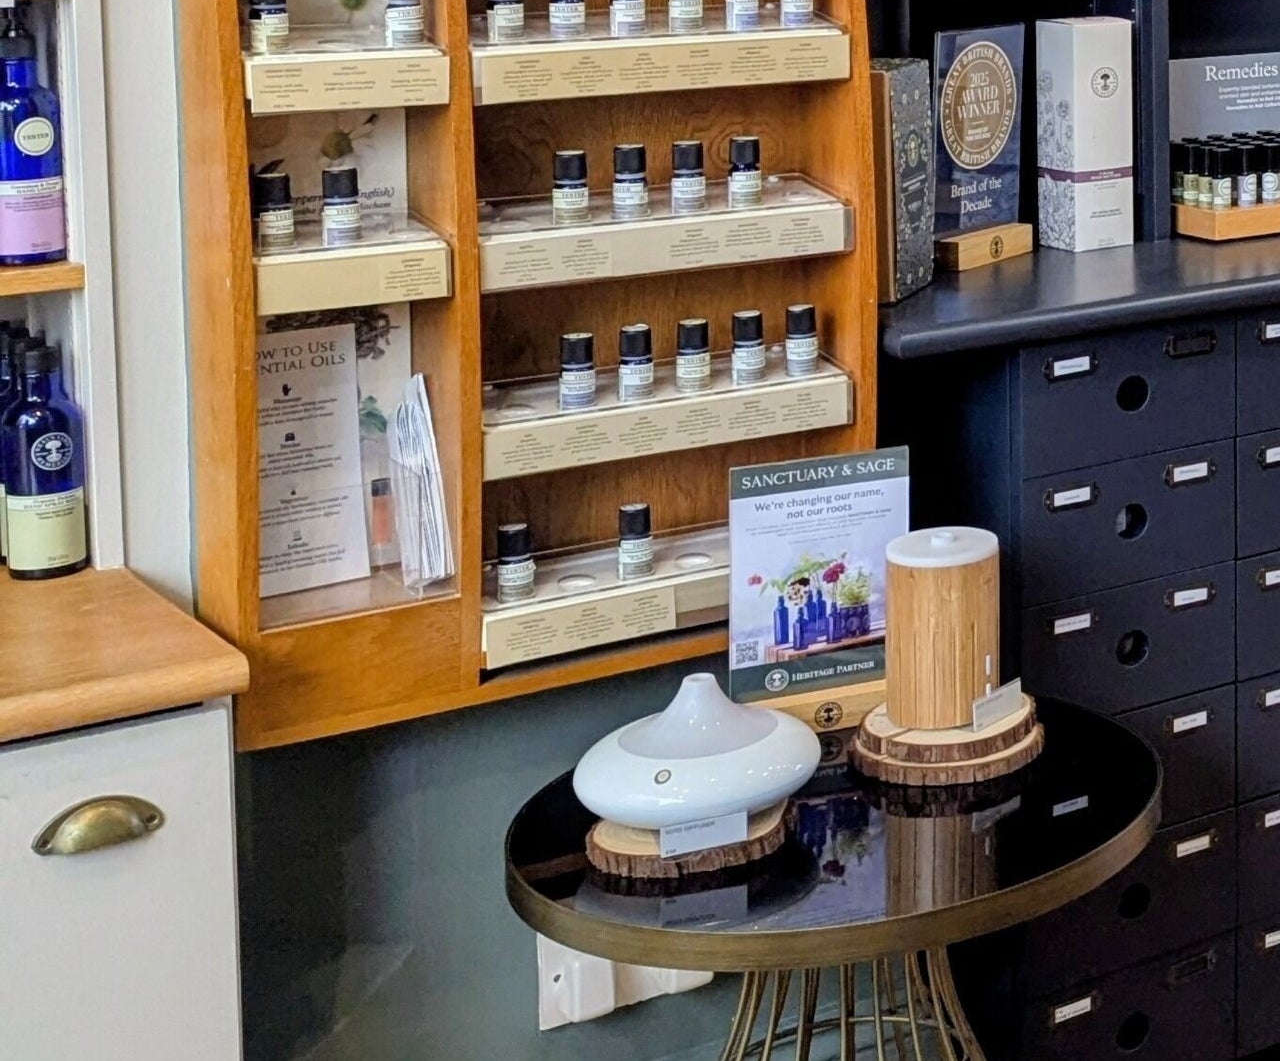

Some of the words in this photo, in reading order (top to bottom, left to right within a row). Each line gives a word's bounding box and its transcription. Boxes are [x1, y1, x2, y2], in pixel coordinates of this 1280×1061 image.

[945, 63, 962, 104] GREAT
[962, 47, 994, 66] BRITISH
[993, 52, 1013, 95] BRANDS
[1205, 60, 1279, 82] Remedies
[959, 85, 999, 105] AWARD
[956, 100, 1001, 121] WINNER
[945, 119, 962, 156] GREAT
[960, 148, 992, 165] BRITISH
[990, 109, 1012, 150] BRANDS
[950, 184, 977, 199] Brand
[978, 178, 989, 191] of
[989, 176, 1003, 189] the
[960, 196, 993, 214] Decade
[281, 345, 303, 358] TO
[308, 341, 338, 354] USE
[310, 353, 346, 368] OILS
[741, 466, 837, 489] SANCTUARY
[841, 464, 852, 476] &
[856, 458, 896, 475] SAGE
[754, 499, 784, 512] We're
[786, 493, 833, 509] changing
[834, 492, 852, 501] our
[853, 488, 885, 500] name,
[786, 509, 804, 520] not
[806, 507, 825, 517] our
[826, 503, 853, 515] roots
[791, 667, 835, 682] HERITAGE
[836, 660, 875, 674] PARTNER
